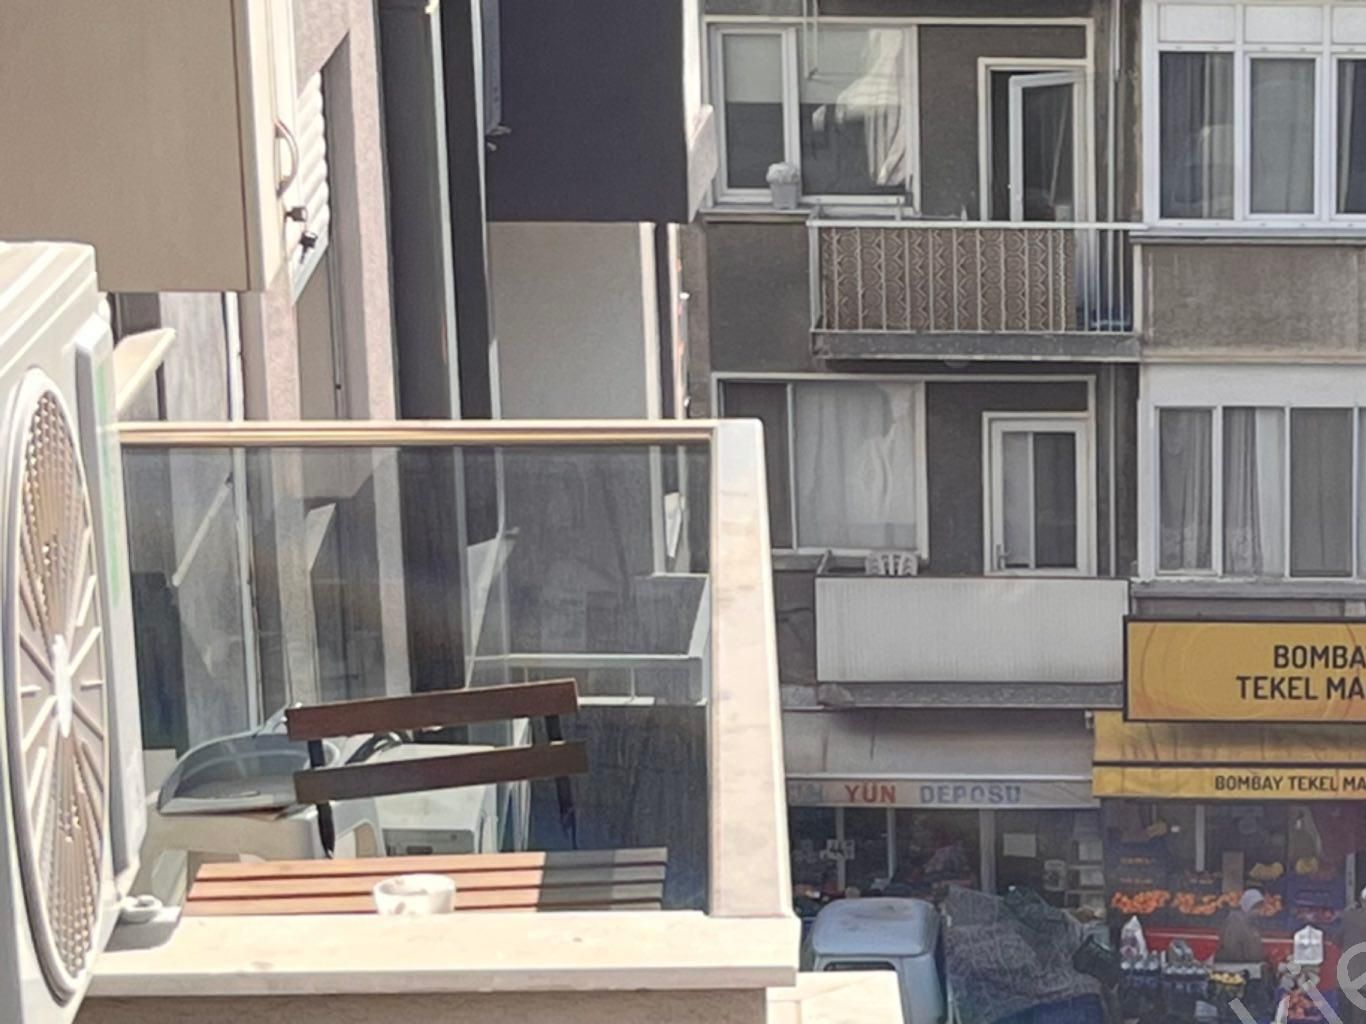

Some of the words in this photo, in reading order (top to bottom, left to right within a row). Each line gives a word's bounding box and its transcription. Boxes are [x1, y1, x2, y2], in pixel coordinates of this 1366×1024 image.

[1236, 676, 1318, 700] TEKEL
[844, 778, 896, 803] YÜN
[920, 784, 1022, 804] DEPOSU
[1214, 774, 1284, 792] BOMBAY
[1289, 774, 1338, 792] TEKEL
